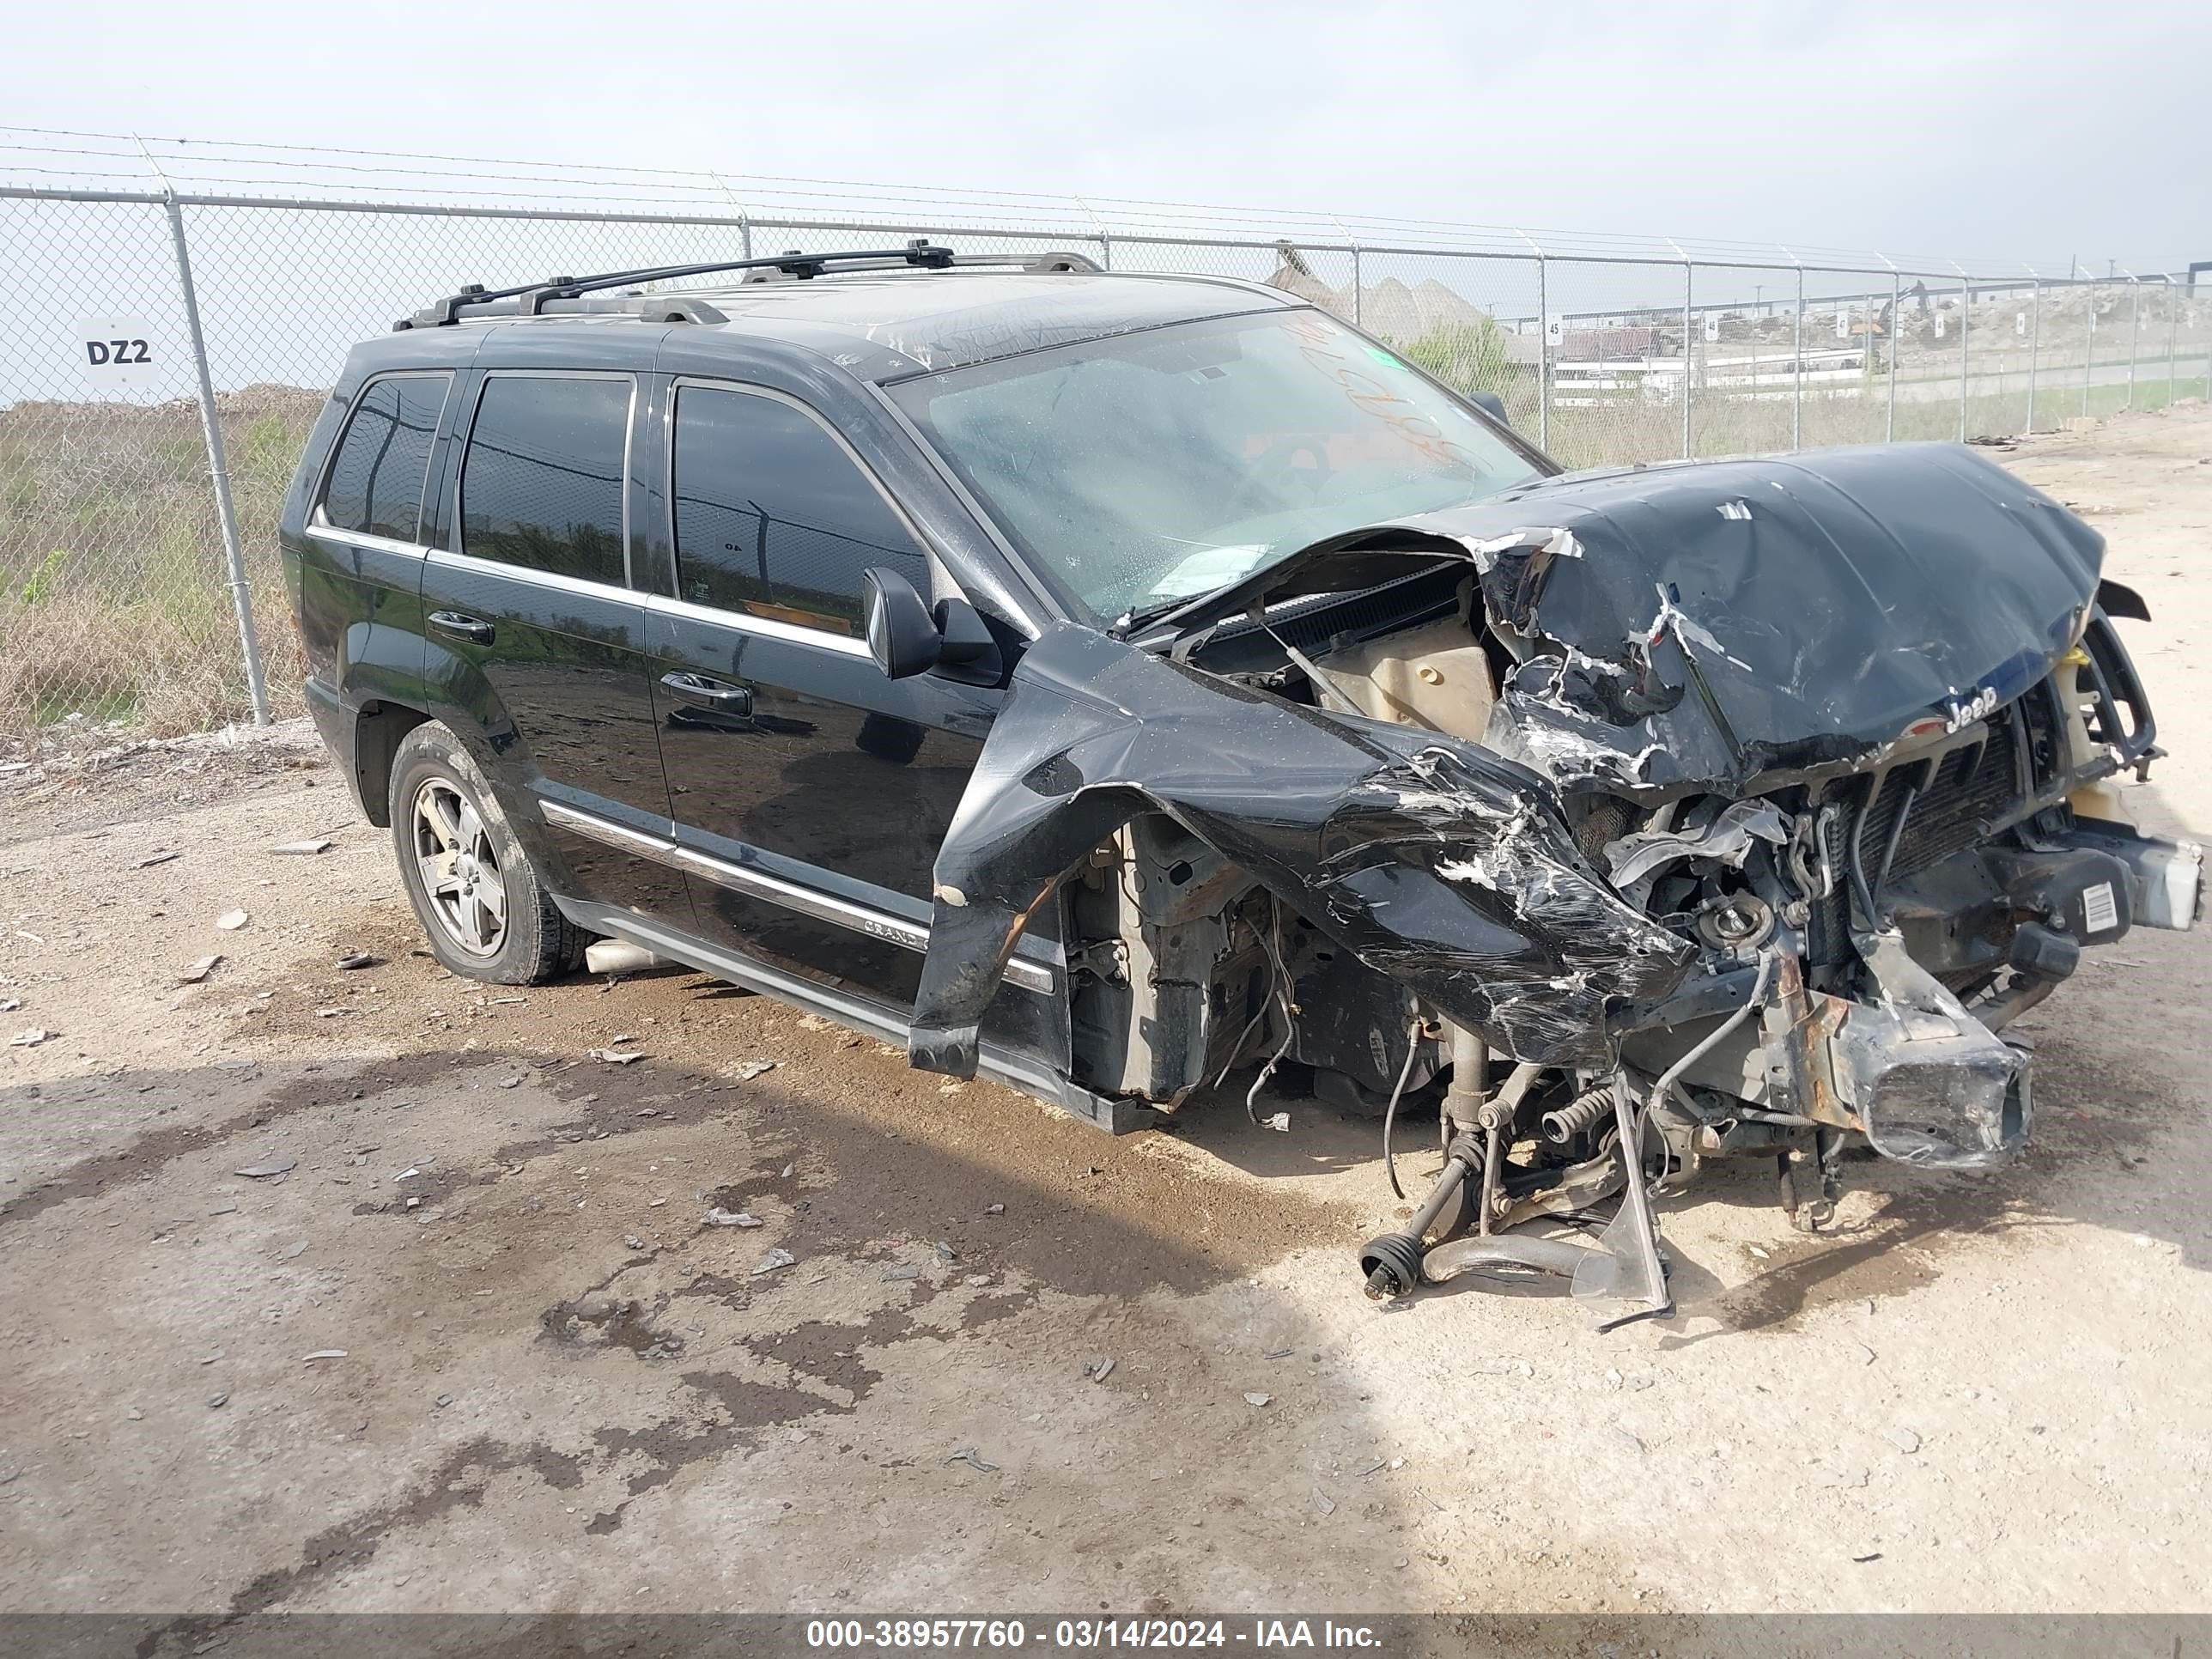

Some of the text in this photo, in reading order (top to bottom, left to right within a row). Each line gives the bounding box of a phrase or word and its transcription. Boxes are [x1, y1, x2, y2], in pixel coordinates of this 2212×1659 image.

[1550, 323, 1559, 335] 45
[87, 339, 152, 365] DZ2
[1946, 686, 1997, 734] Jeep
[865, 921, 917, 945] GRAND
